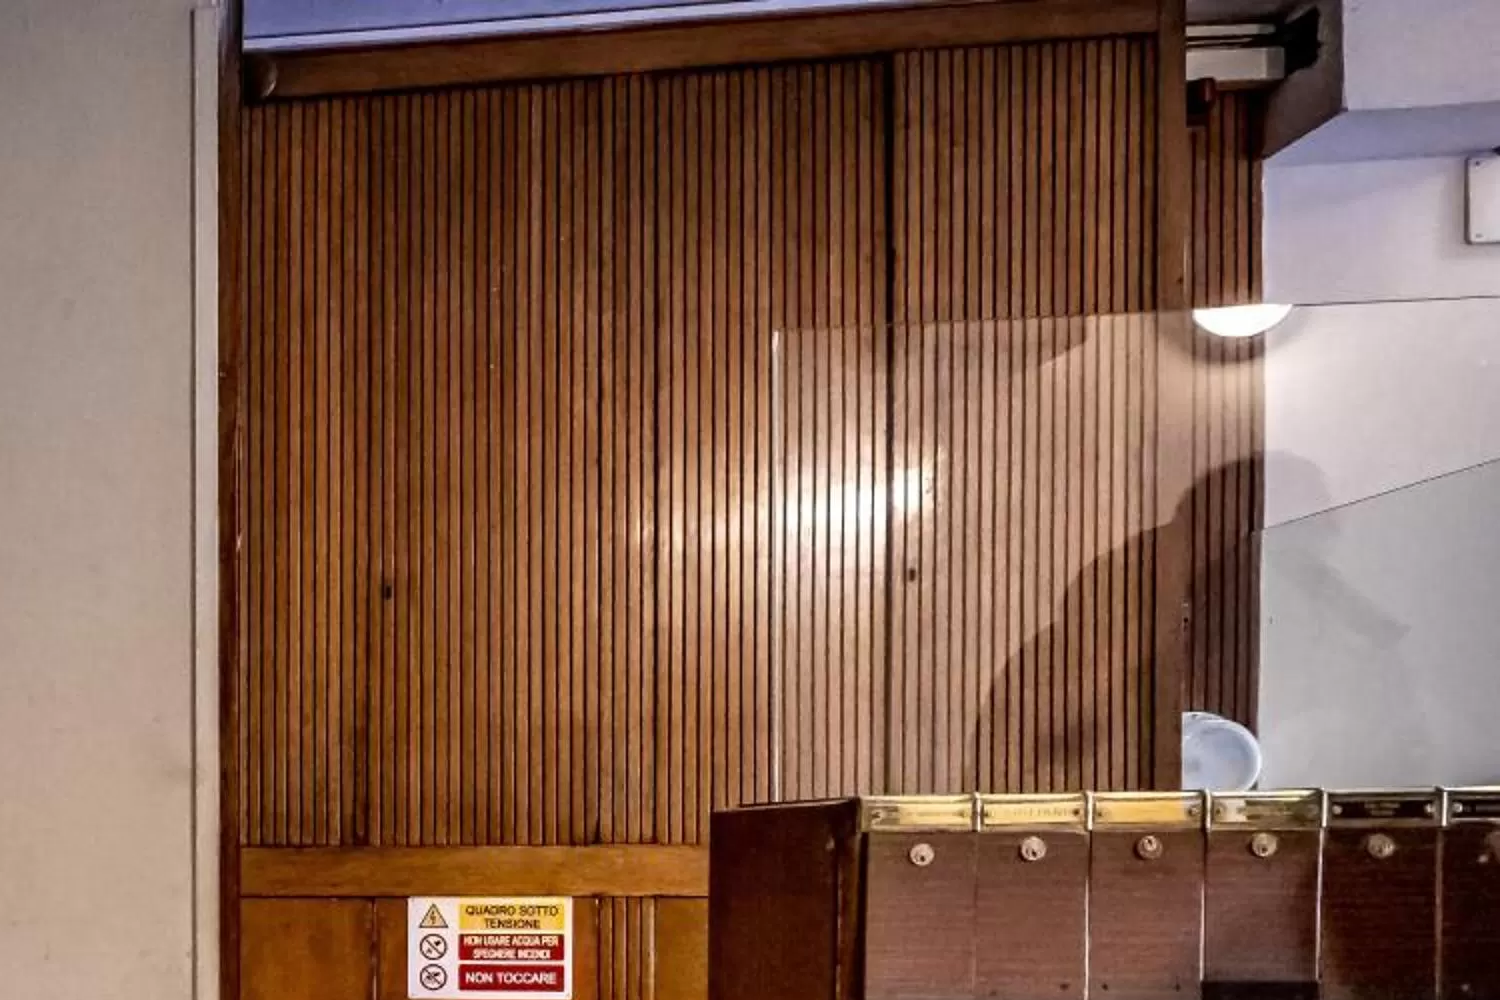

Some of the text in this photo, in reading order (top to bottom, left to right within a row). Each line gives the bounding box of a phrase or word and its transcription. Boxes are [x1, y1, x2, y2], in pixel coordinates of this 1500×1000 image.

[465, 905, 558, 916] QUADRO SOTTO
[484, 918, 540, 929] TENSIONE
[463, 936, 559, 947] NON USARE ACQUA PER
[465, 971, 557, 985] NON TOCCARE
